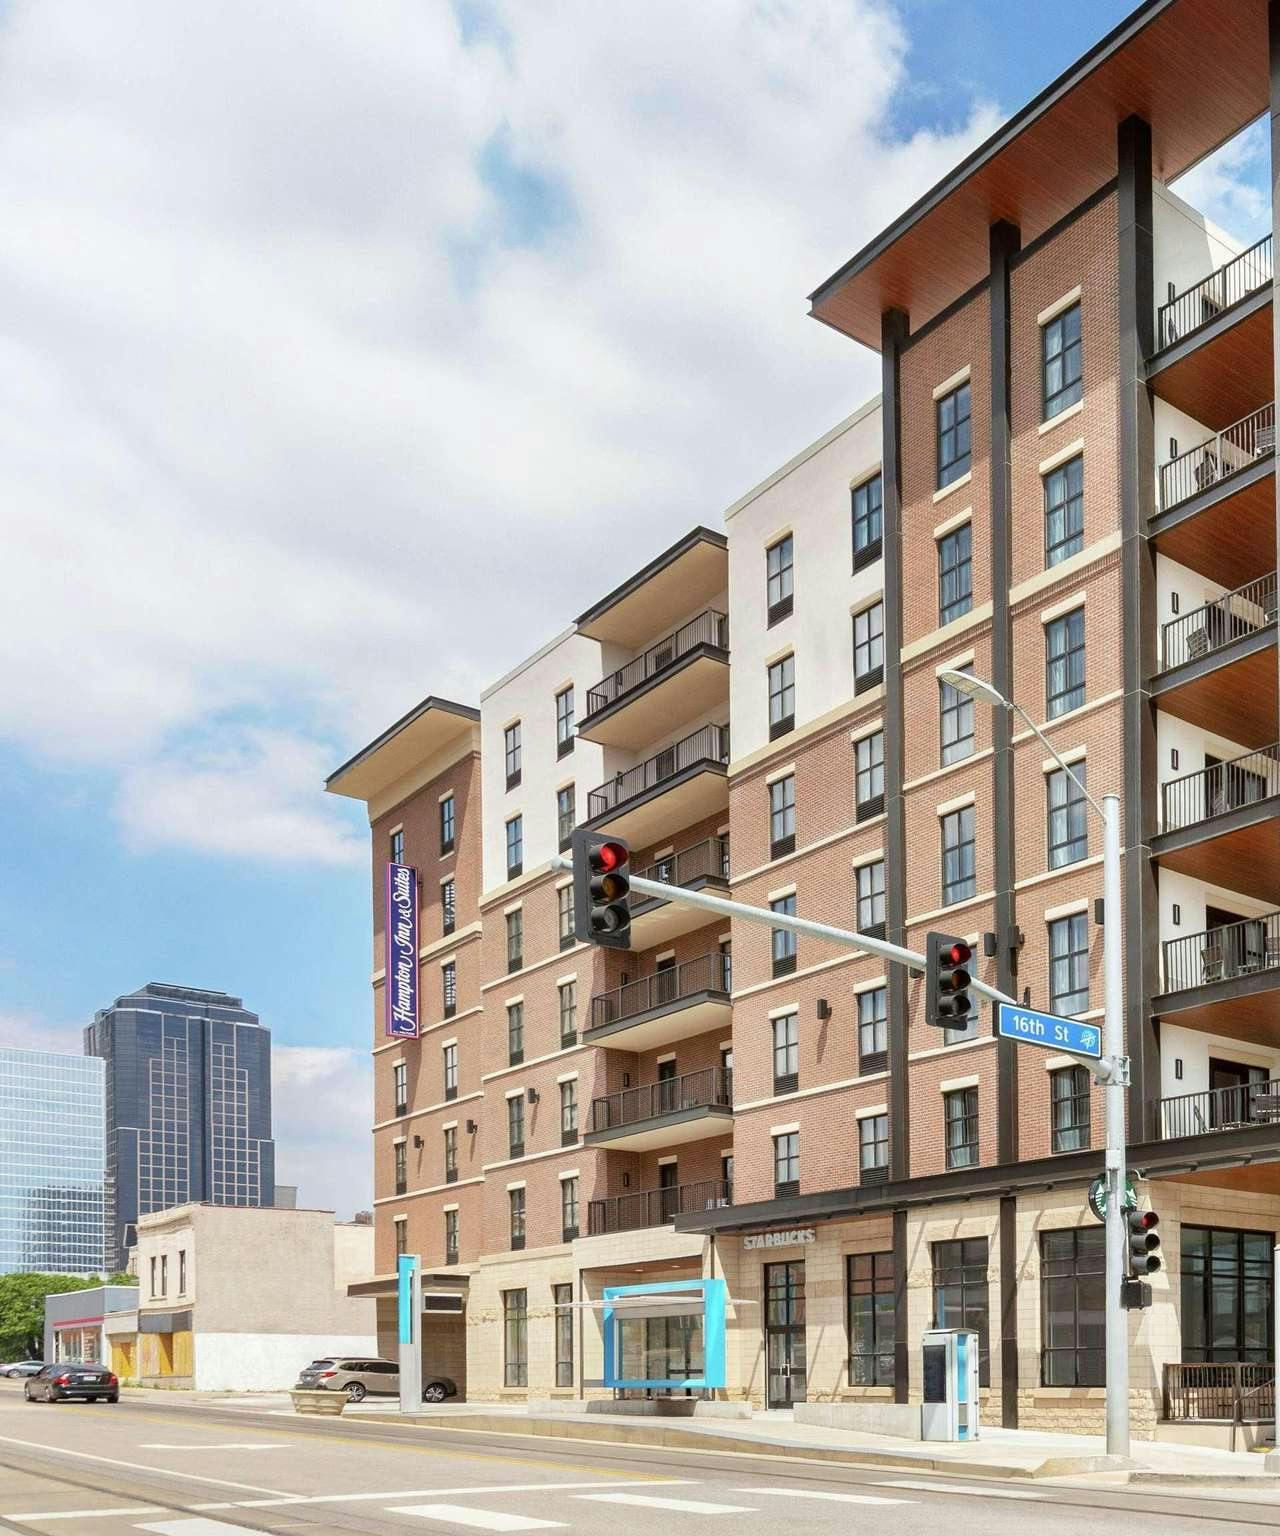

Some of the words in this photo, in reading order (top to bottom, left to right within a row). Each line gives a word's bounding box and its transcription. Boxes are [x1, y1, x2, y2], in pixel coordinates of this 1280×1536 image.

[392, 868, 412, 908] Suites
[393, 916, 414, 956] Inn
[392, 955, 416, 1032] Hampton
[1013, 1015, 1045, 1036] 16th
[1054, 1025, 1070, 1042] St
[743, 1228, 816, 1250] STARBUCKS
